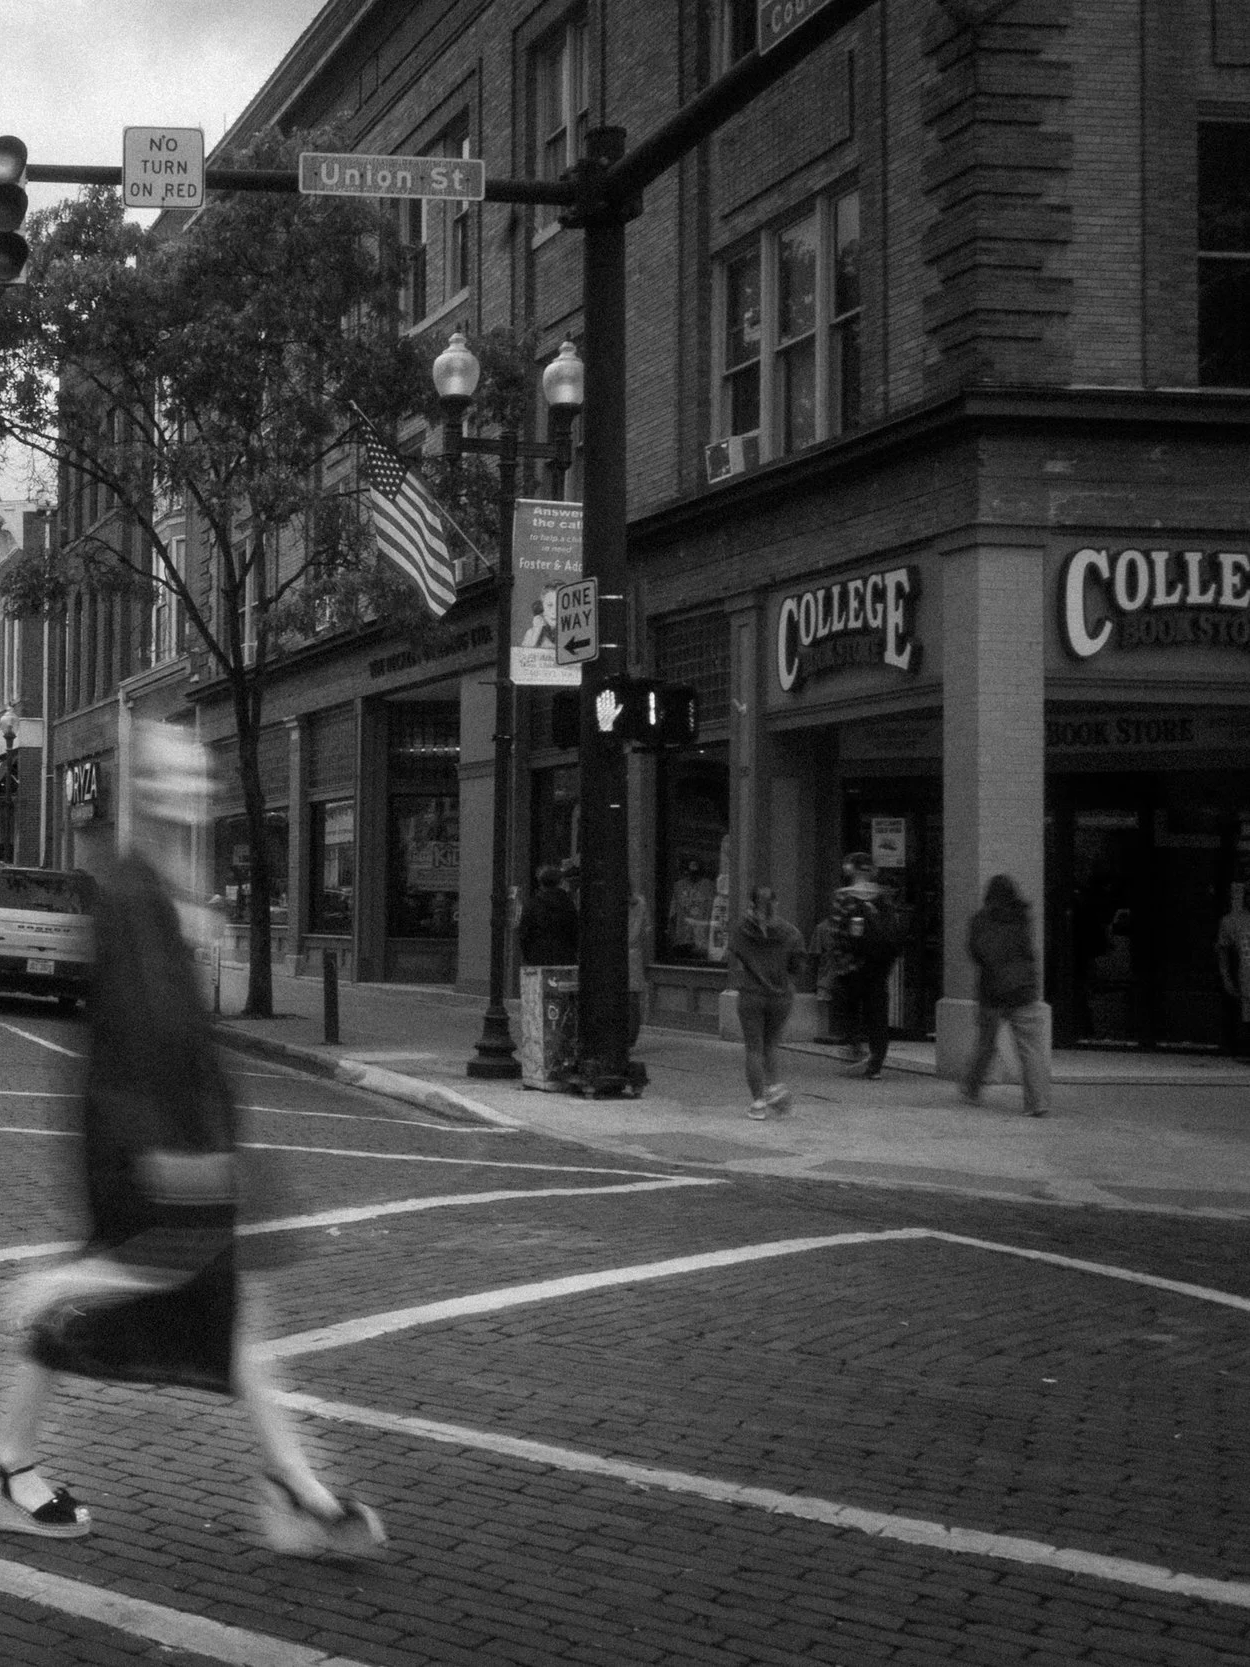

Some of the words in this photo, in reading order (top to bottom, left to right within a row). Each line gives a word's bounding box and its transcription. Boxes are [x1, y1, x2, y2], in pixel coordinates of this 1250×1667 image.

[150, 137, 178, 152] NO
[141, 160, 188, 174] TURN
[321, 163, 412, 188] Union
[431, 167, 464, 190] St
[130, 183, 153, 197] ON
[165, 183, 197, 198] RED
[533, 518, 555, 528] the
[519, 557, 551, 570] Foster
[554, 559, 562, 571] &
[562, 587, 591, 610] ONE
[561, 609, 592, 632] WAY
[778, 568, 911, 691] COLLEGE
[66, 763, 98, 803] ORYZA
